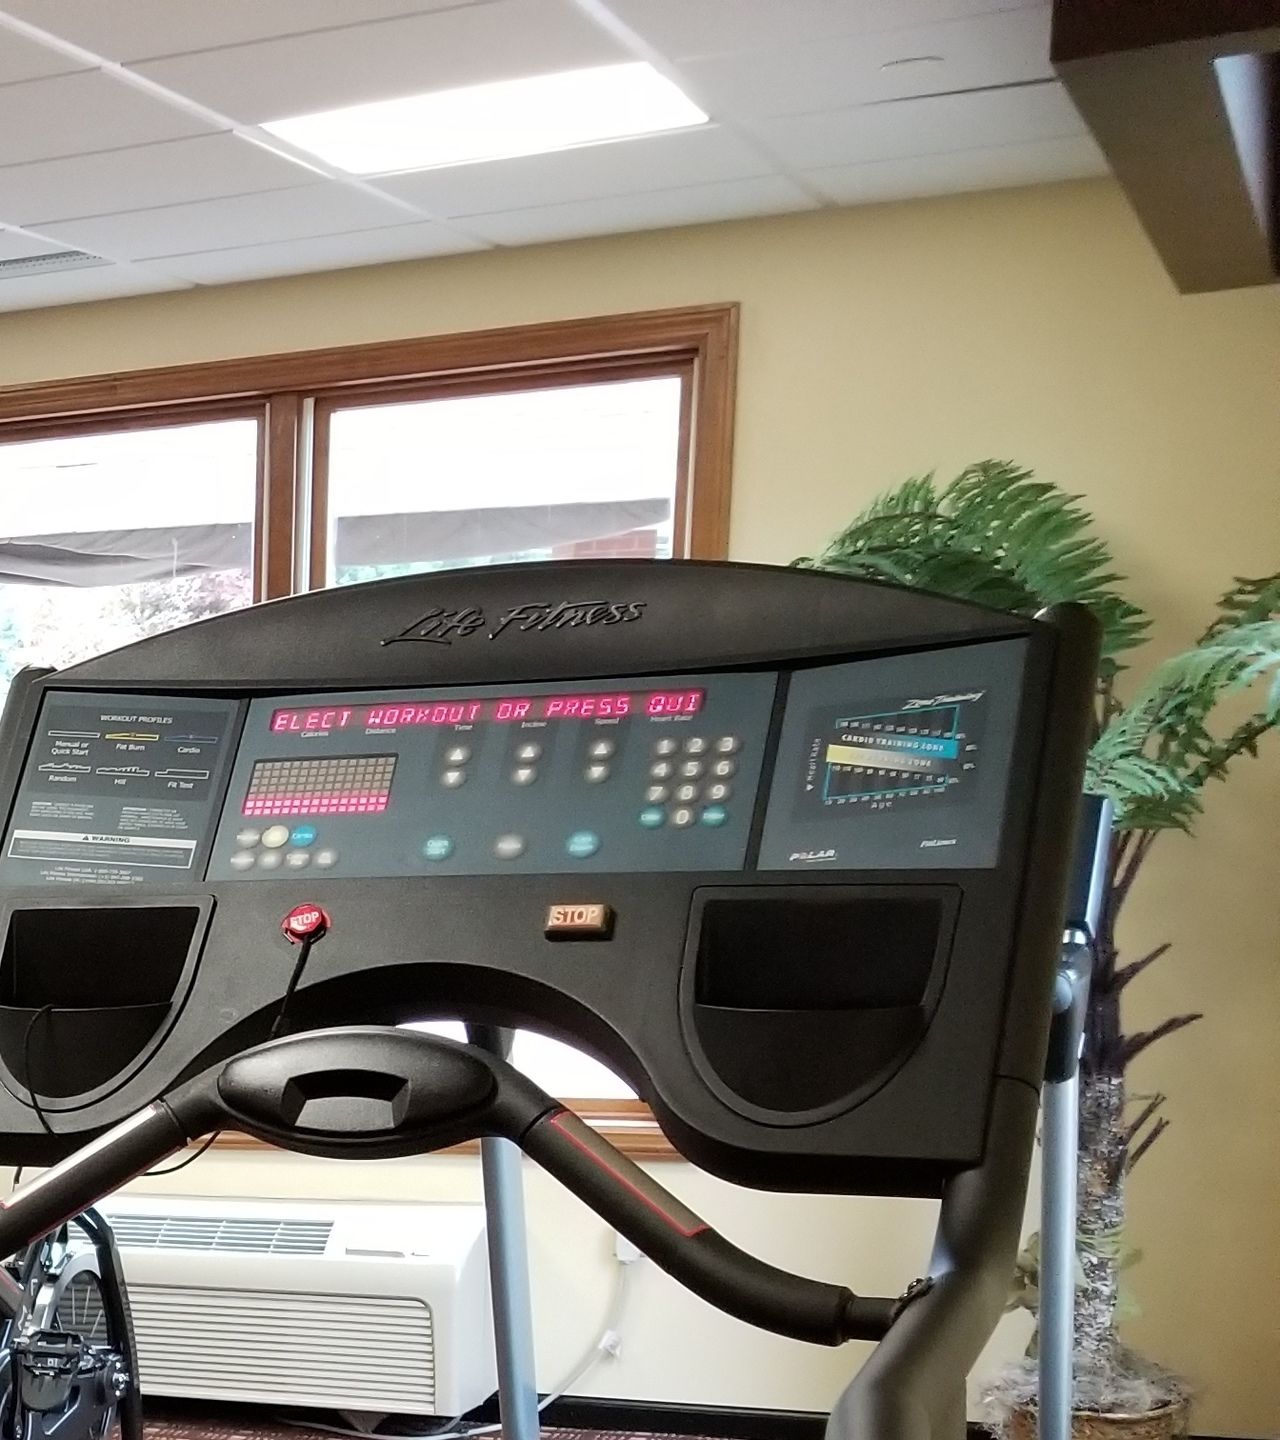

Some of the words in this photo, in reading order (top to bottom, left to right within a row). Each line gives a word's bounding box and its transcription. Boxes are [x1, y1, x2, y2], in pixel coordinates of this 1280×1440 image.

[380, 606, 486, 646] Life
[489, 600, 647, 640] Fitness
[367, 704, 481, 725] WORKOUT
[497, 702, 532, 720] OR
[547, 697, 631, 717] PRESS
[100, 714, 137, 723] WORKOUT
[138, 716, 173, 725] PROFILES
[658, 740, 670, 754] 1
[691, 738, 703, 753] 2
[720, 736, 734, 751] 3
[653, 762, 667, 777] 4
[686, 761, 699, 776] 5
[716, 760, 729, 775] 6
[648, 786, 663, 801] 7
[681, 785, 695, 800] 8
[712, 784, 725, 799] 9
[552, 907, 599, 925] STOP
